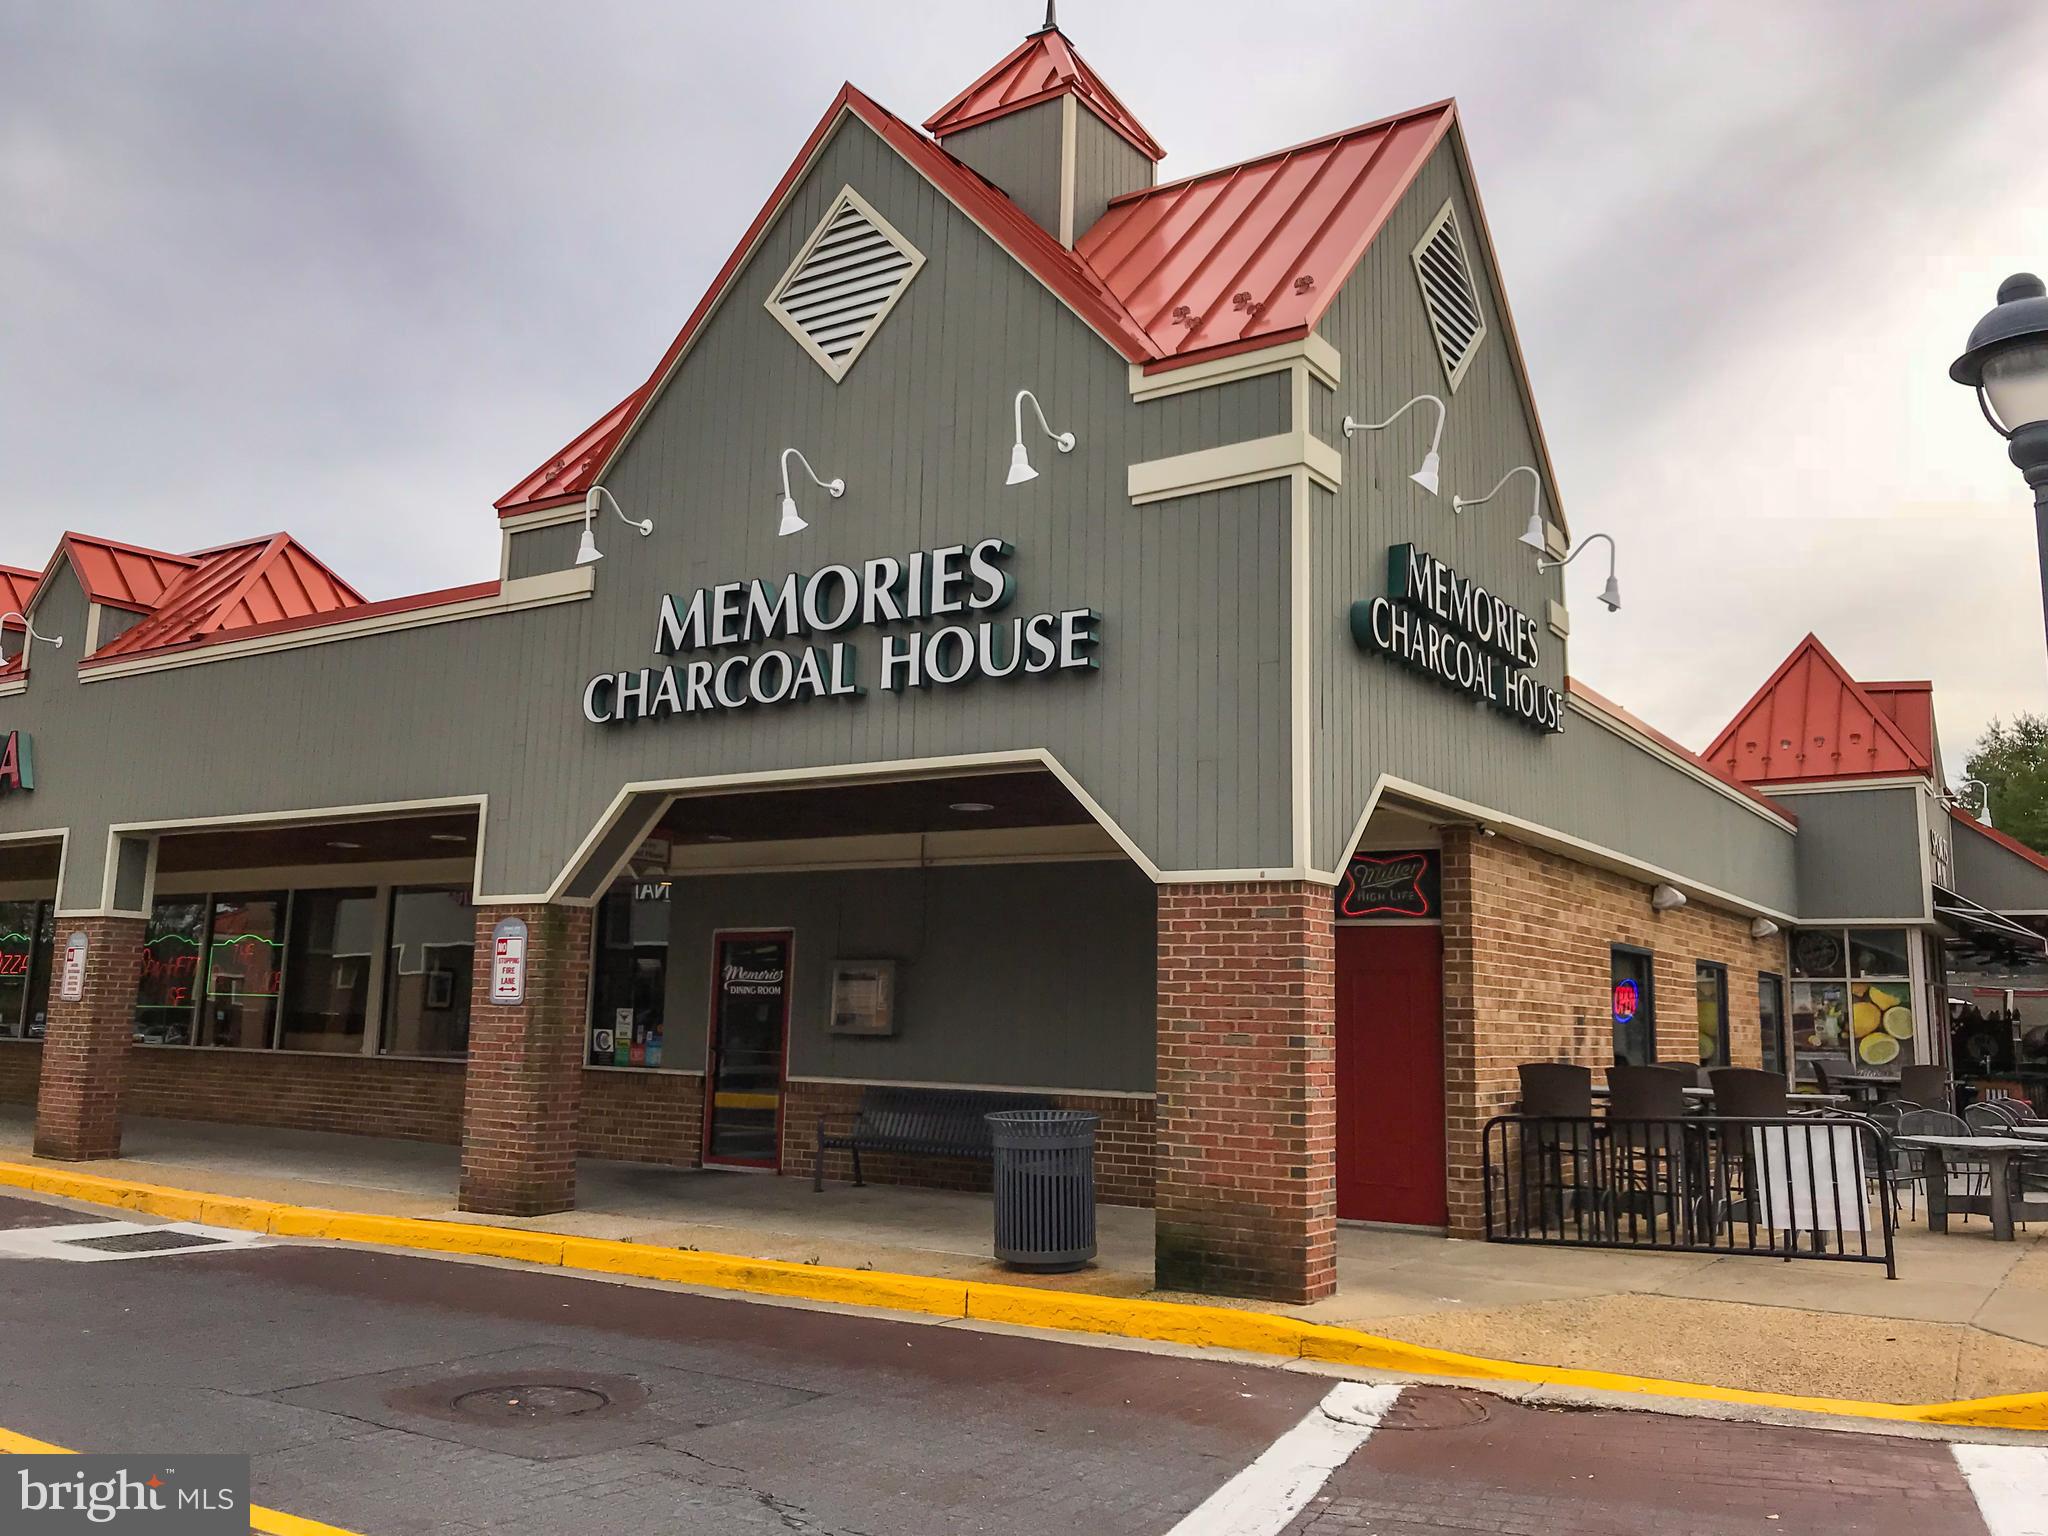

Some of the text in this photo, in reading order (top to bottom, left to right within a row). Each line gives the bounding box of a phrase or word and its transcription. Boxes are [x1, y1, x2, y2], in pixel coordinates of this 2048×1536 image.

[654, 538, 1007, 655] MEMORIES
[1407, 543, 1539, 668] MEMORIES
[582, 608, 1092, 723] CHARCOAL HOUSE
[1372, 597, 1564, 733] CHARCOAL HOUSE
[1354, 863, 1420, 888] Miller
[501, 977, 515, 985] LANE
[723, 964, 784, 983] Memories
[730, 985, 781, 995] DINING ROOM
